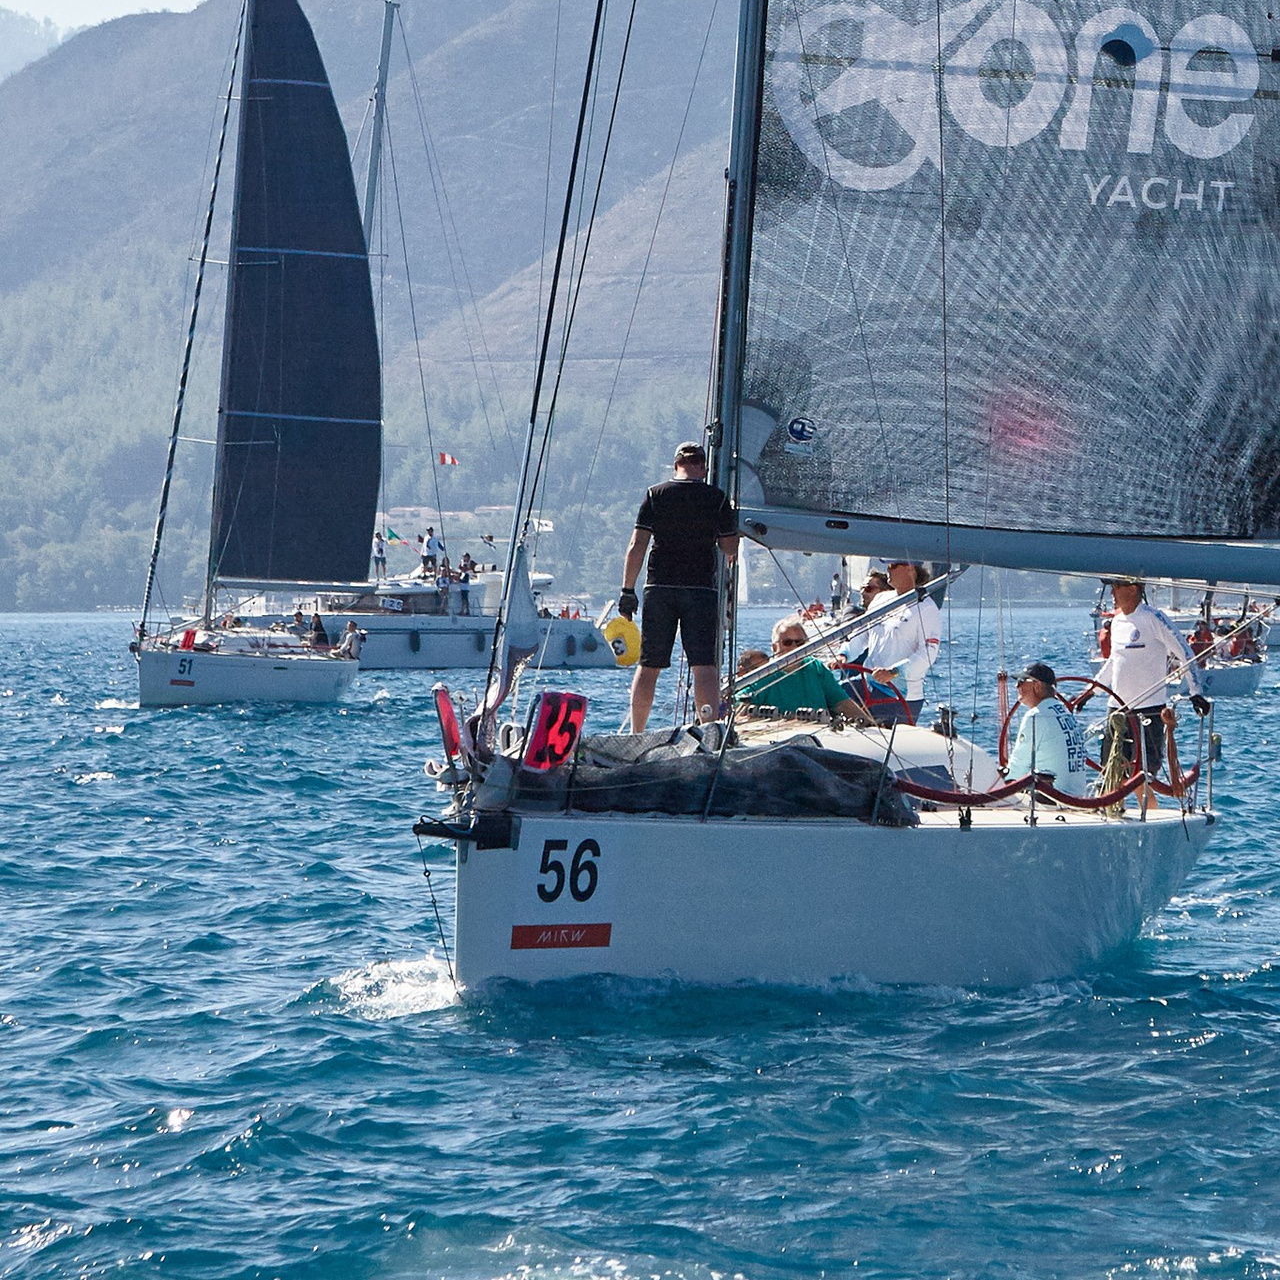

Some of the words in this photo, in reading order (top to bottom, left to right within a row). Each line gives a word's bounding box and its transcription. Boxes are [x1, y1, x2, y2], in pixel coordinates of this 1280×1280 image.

[1083, 173, 1235, 212] YACHT
[178, 658, 193, 675] 51
[536, 838, 602, 903] 56
